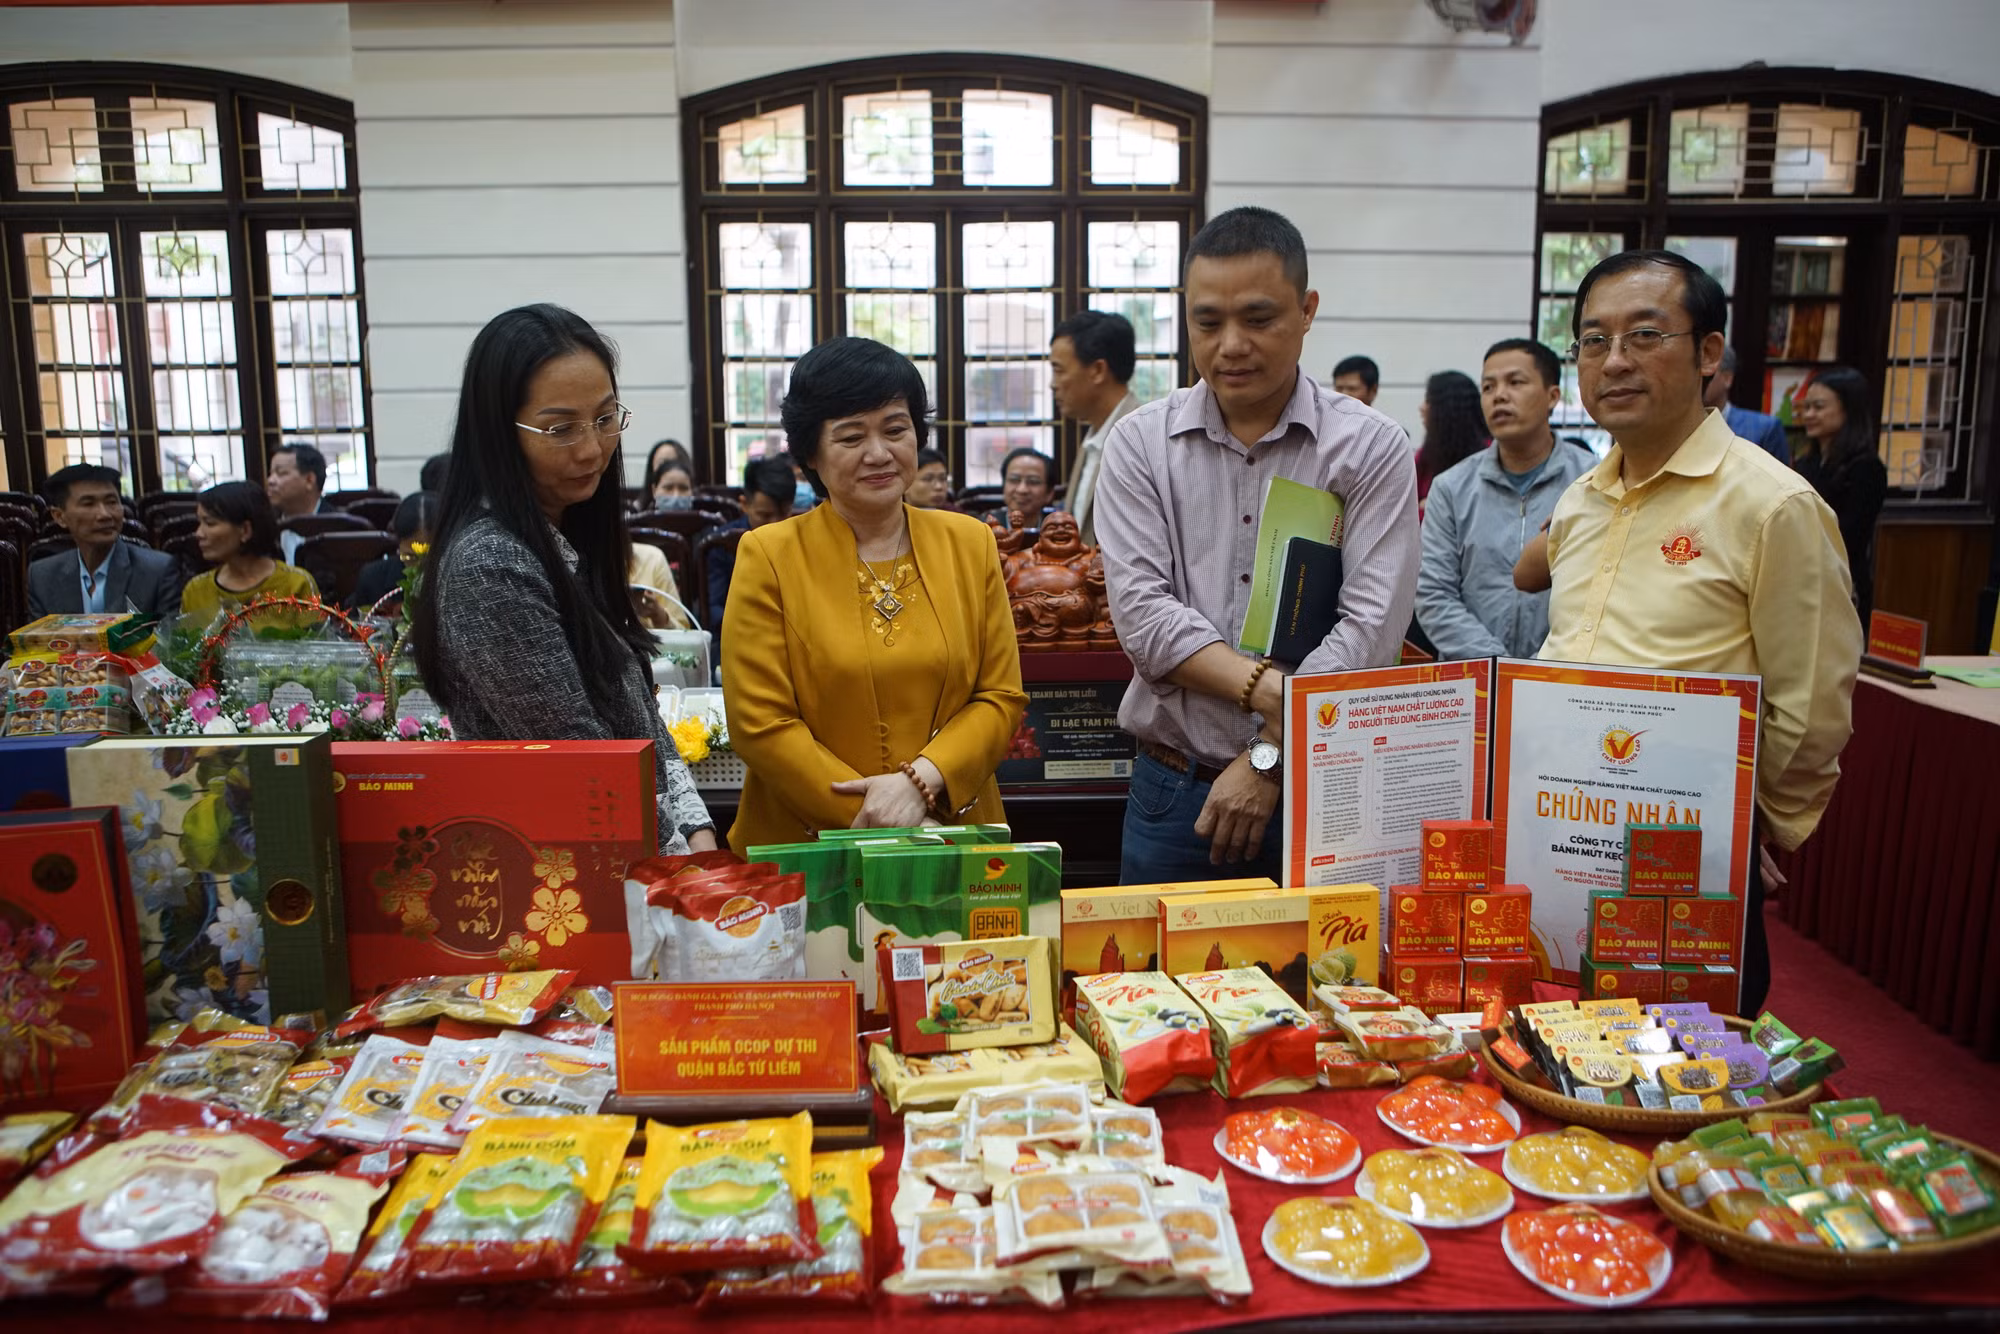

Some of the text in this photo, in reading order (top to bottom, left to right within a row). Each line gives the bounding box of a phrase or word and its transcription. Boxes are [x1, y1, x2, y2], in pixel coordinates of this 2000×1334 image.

[1360, 695, 1371, 703] CHẾ
[1371, 694, 1379, 702] SỬ
[1379, 694, 1393, 703] DỤNG
[1394, 691, 1410, 700] NHÃN
[1410, 690, 1422, 699] HIỆU
[1423, 688, 1440, 697] CHỨNG
[1441, 687, 1456, 695] NHẬN
[1349, 698, 1464, 717] HÀNG VIỆT NAM CHẤT LƯỢNG CAO
[1349, 720, 1359, 729] DO
[1360, 716, 1382, 729] NGƯỜI
[1383, 714, 1400, 726] TIÊU
[1401, 712, 1421, 725] DÙNG
[1422, 710, 1439, 722] BÌNH
[1440, 709, 1459, 721] CHỌN
[359, 779, 413, 791] BẢO MINH
[1550, 776, 1572, 784] DOANH
[1573, 778, 1596, 787] NGHIỆP
[1597, 779, 1615, 788] HÀNG
[1616, 781, 1629, 790] VIỆT
[1646, 785, 1664, 794] CHẤT
[1664, 788, 1686, 796] LƯỢNG
[1536, 786, 1616, 825] CHỨNG
[1570, 835, 1614, 849] CÔNG TY
[1551, 844, 1579, 855] BÁNH
[1428, 868, 1485, 880] BẢO MINH
[1555, 867, 1572, 875] HÀNG
[1573, 869, 1587, 877] VIỆT
[1603, 873, 1619, 882] CHẤT
[1635, 868, 1694, 880] BẢO MINH
[969, 882, 1022, 894] BẢO MINH
[1595, 879, 1608, 887] TIÊU
[738, 905, 765, 924] MINH
[1110, 901, 1140, 916] Viet
[1212, 907, 1286, 924] Viet Nam
[977, 910, 1014, 930] BÁNH
[1320, 915, 1368, 950] Pía
[1399, 934, 1455, 945] BẢO MINH
[1469, 934, 1524, 945] BẢO MINH
[1599, 936, 1658, 948] BẢO MINH
[1671, 937, 1730, 949] BẢO MINH
[961, 955, 992, 969] BẢO MINH
[1102, 972, 1123, 982] MINH
[1201, 974, 1223, 982] MINH
[694, 1001, 774, 1012] THÀNH PHỐ HÀ NỘI
[1425, 1005, 1455, 1013] MINH
[659, 1034, 817, 1056] SẢN PHẨM OCOP DỰ THI
[677, 1057, 801, 1080] QUẬN BẮC TỪ LIÊM
